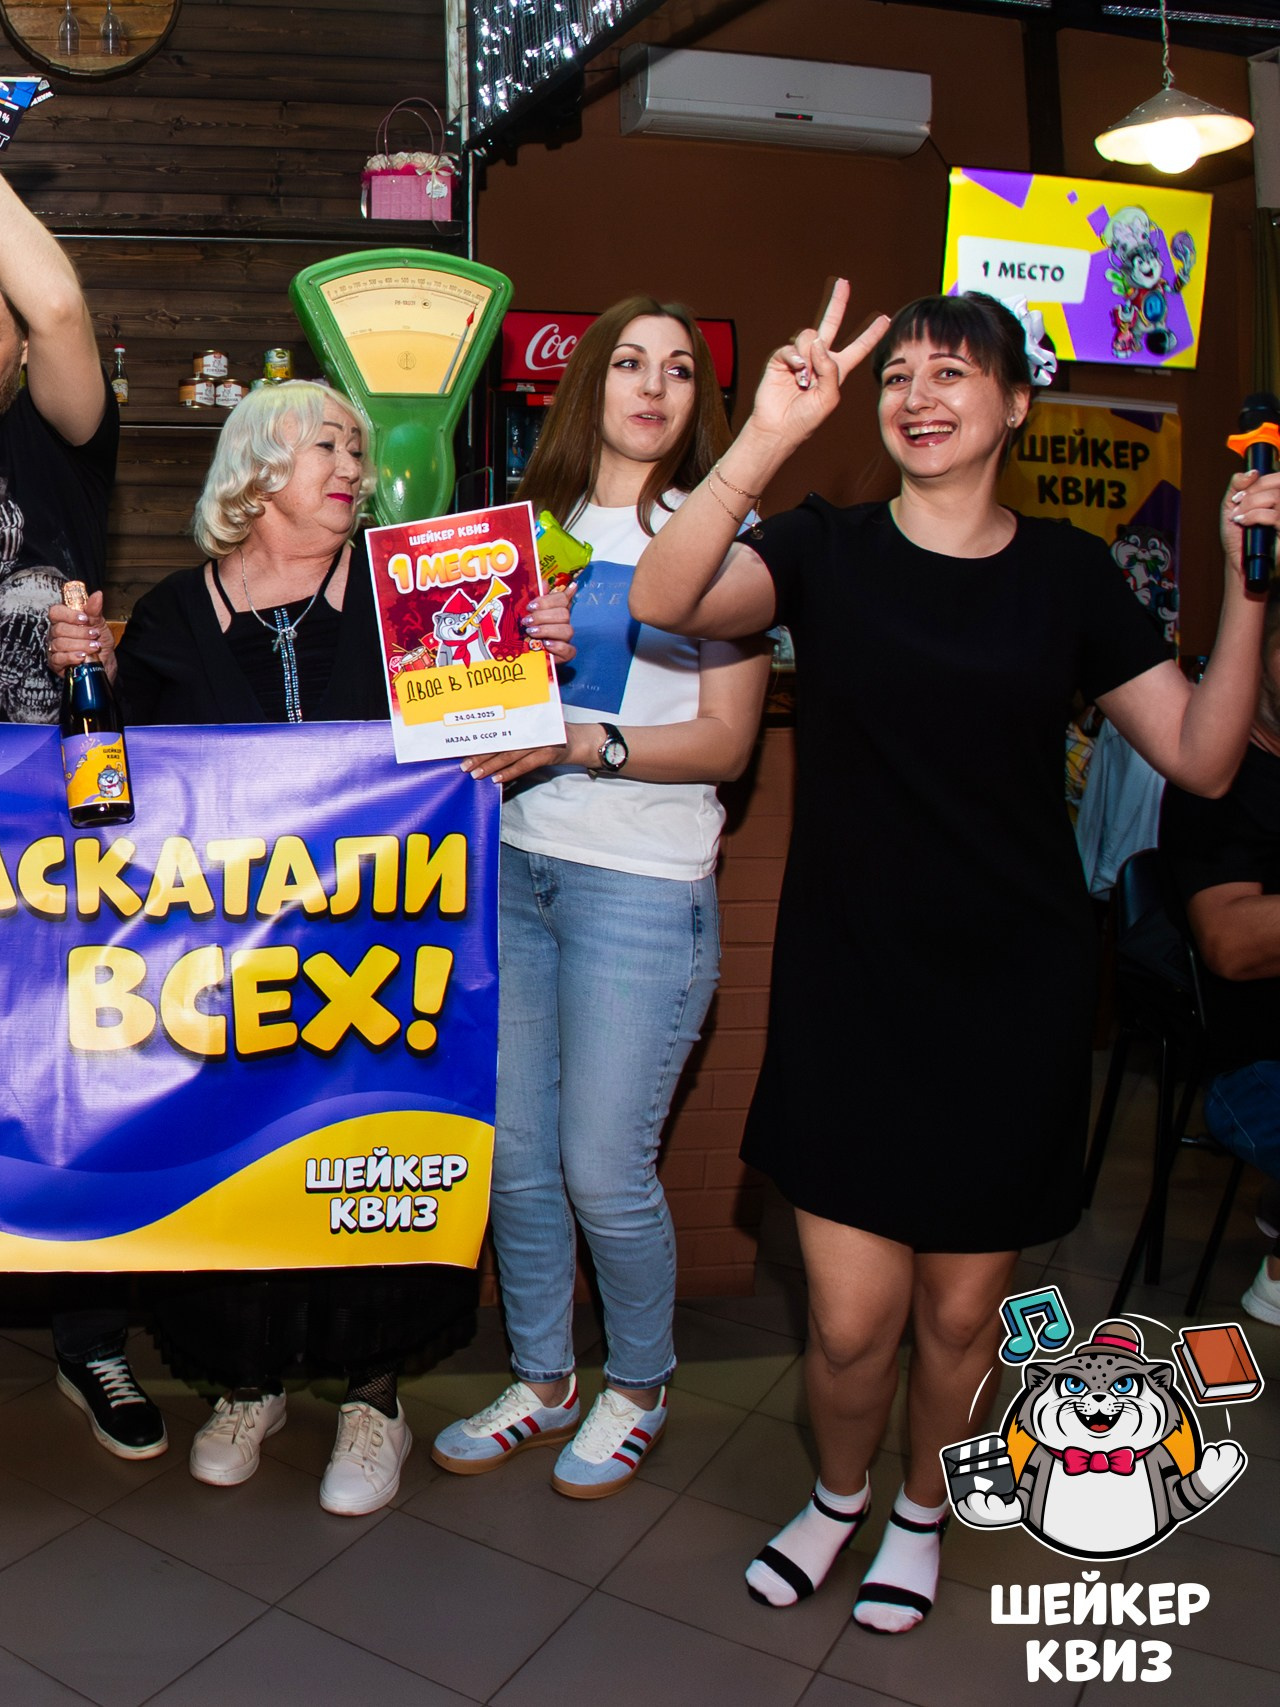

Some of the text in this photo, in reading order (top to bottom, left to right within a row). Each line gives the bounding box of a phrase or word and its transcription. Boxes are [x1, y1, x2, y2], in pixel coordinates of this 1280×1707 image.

[982, 261, 1065, 281] 1 МЕСТО
[1018, 428, 1150, 471] ШЕЙКЕР
[1037, 475, 1127, 509] КВИЗ
[409, 523, 490, 546] ШЕЙКЕР КВИЗ
[390, 541, 517, 592] 1 МЕСТО
[406, 663, 527, 703] ДВОЕ В ГОРОДЕ
[454, 711, 495, 721] 24.04.2025
[445, 735, 471, 743] НАЗАД
[480, 731, 497, 739] СССР
[66, 944, 454, 1060] ВСЕХ!
[306, 1147, 468, 1193] ШЕЙКЕР
[330, 1195, 438, 1234] КВИЗ
